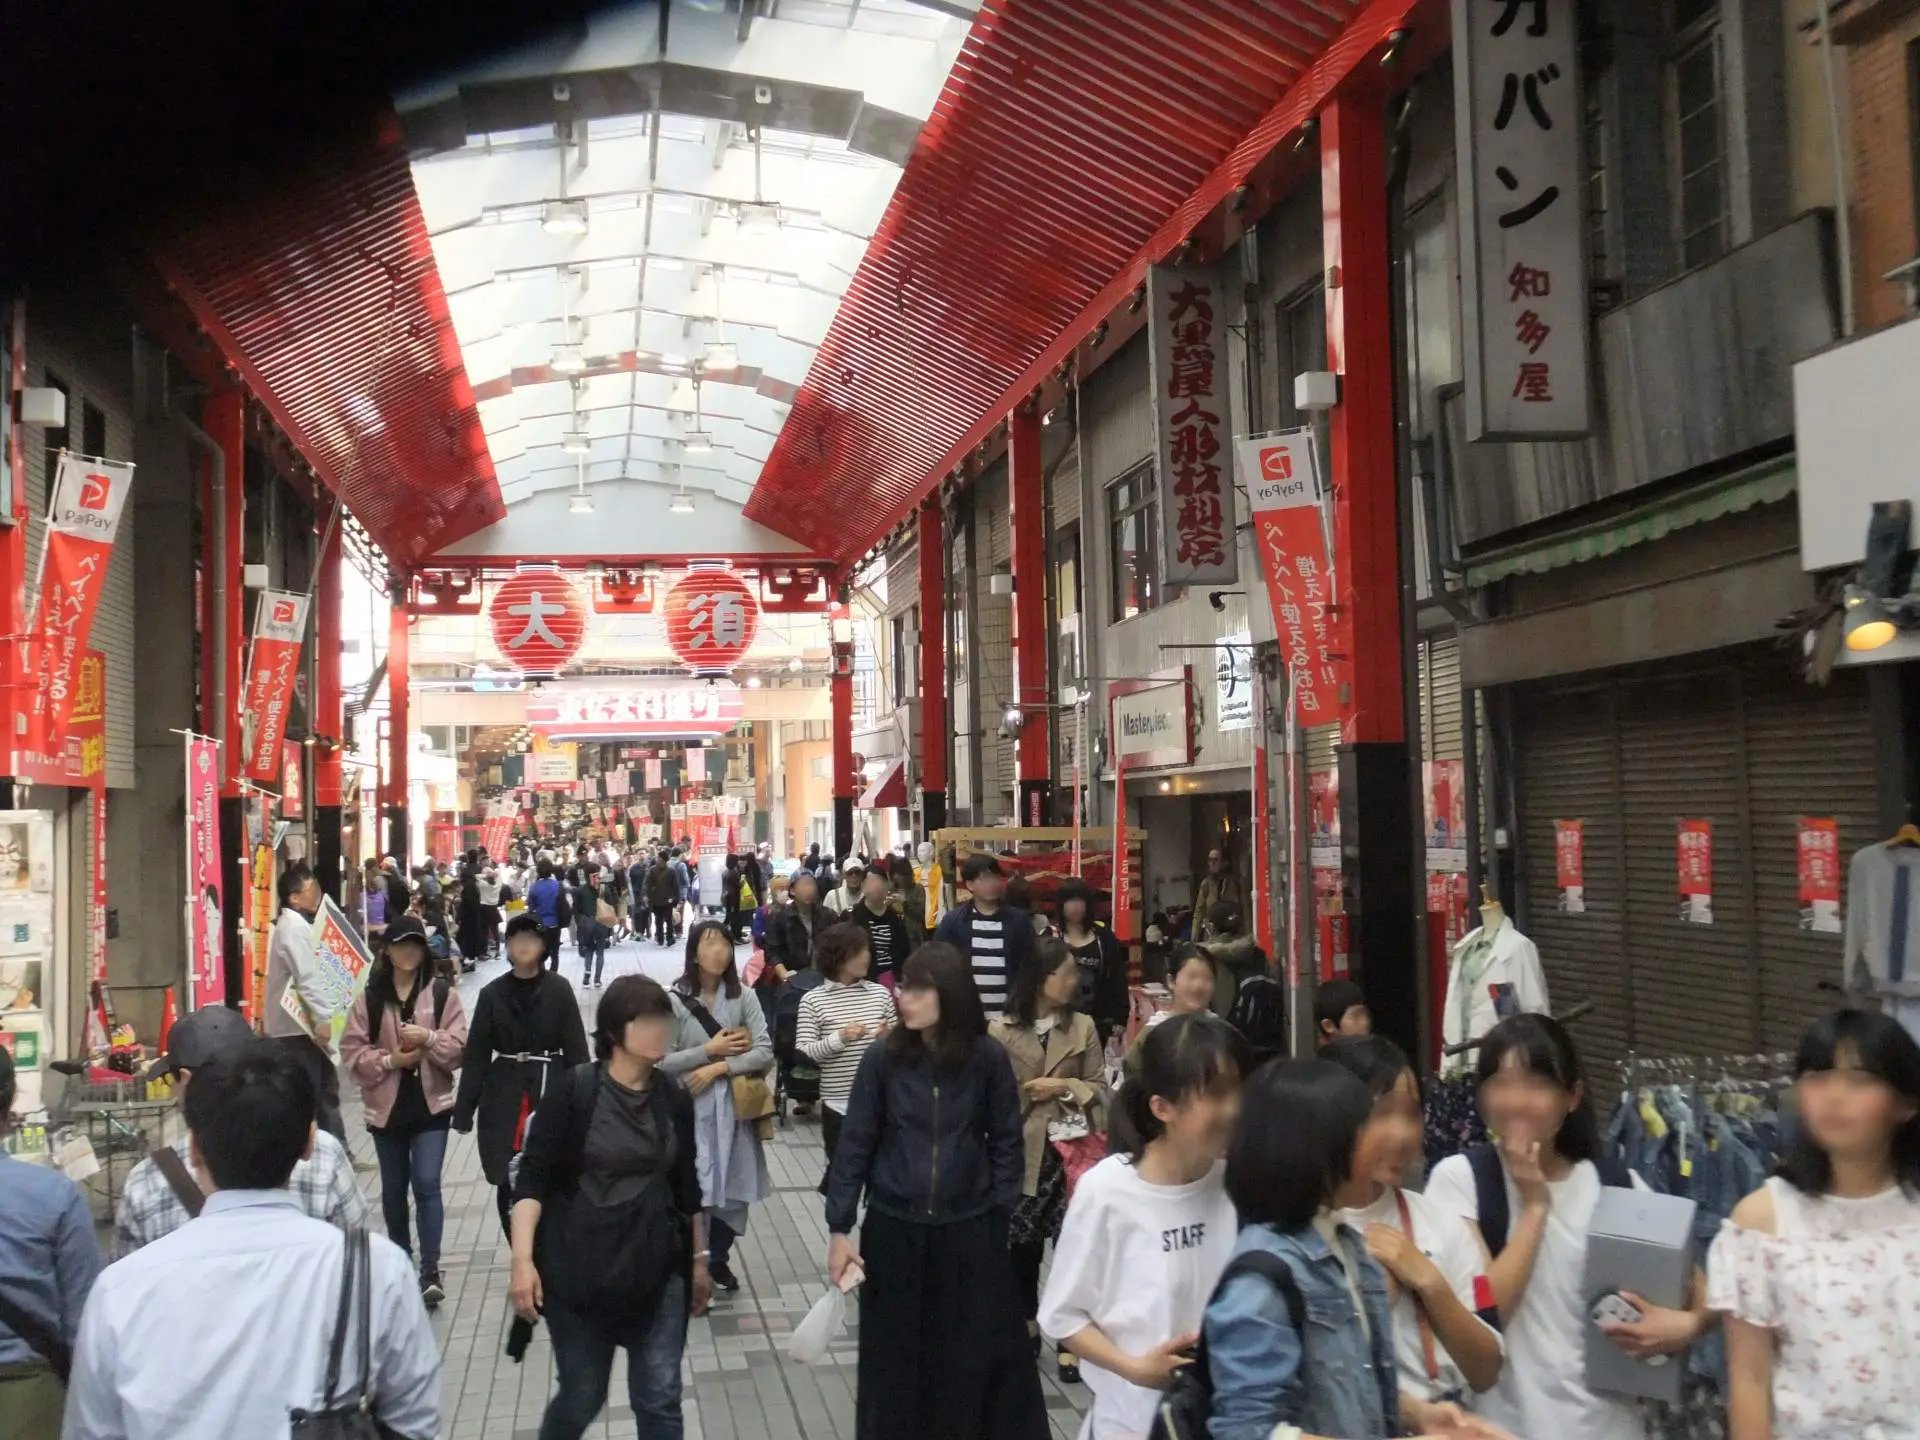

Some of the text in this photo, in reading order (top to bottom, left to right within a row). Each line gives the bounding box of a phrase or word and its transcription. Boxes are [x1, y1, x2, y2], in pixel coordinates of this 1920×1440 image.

[1490, 0, 1561, 228] カバン
[1508, 262, 1554, 402] 知多屋
[1167, 280, 1226, 569] 大黒屋人形材料店
[65, 509, 113, 531] PaPay
[507, 592, 566, 649] 大
[686, 592, 746, 649] 須
[256, 648, 294, 770] ペイペイ使えるお店
[1162, 1223, 1206, 1252] STAFF
